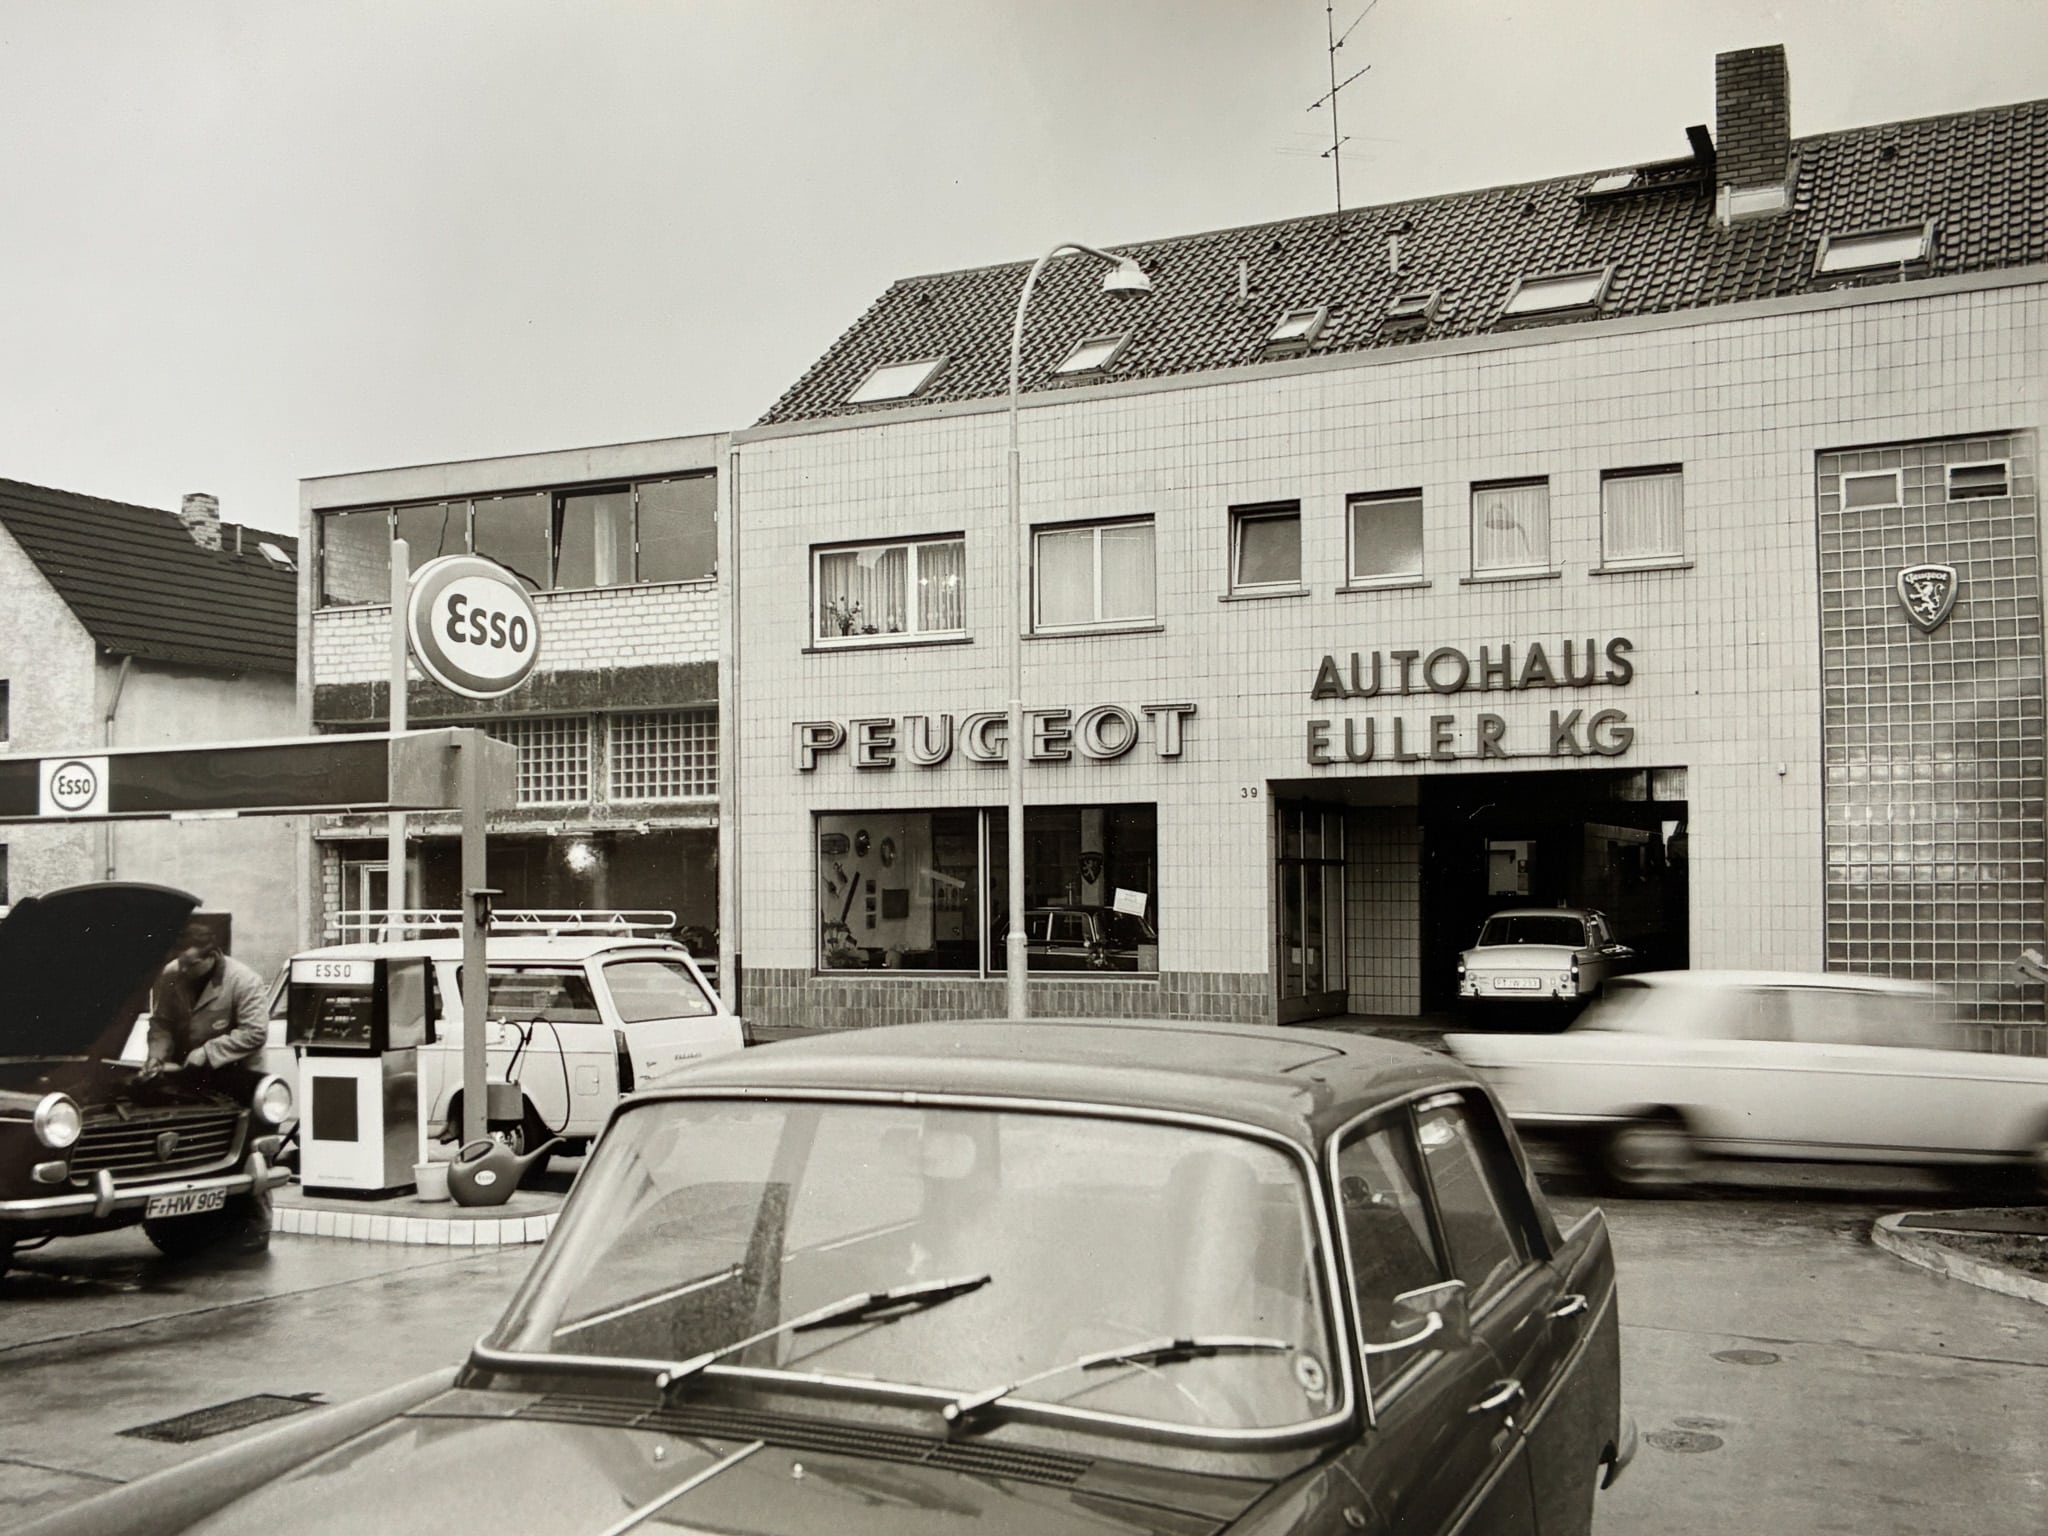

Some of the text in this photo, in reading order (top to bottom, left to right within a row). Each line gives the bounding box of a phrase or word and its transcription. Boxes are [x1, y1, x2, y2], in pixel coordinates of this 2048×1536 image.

[1310, 636, 1634, 700] AUTOHAUS
[791, 703, 1197, 770] PEUGEOT
[1306, 708, 1635, 765] EULER KG
[1241, 787, 1258, 798] 39
[315, 964, 352, 978] ESSO
[197, 1190, 225, 1210] 905
